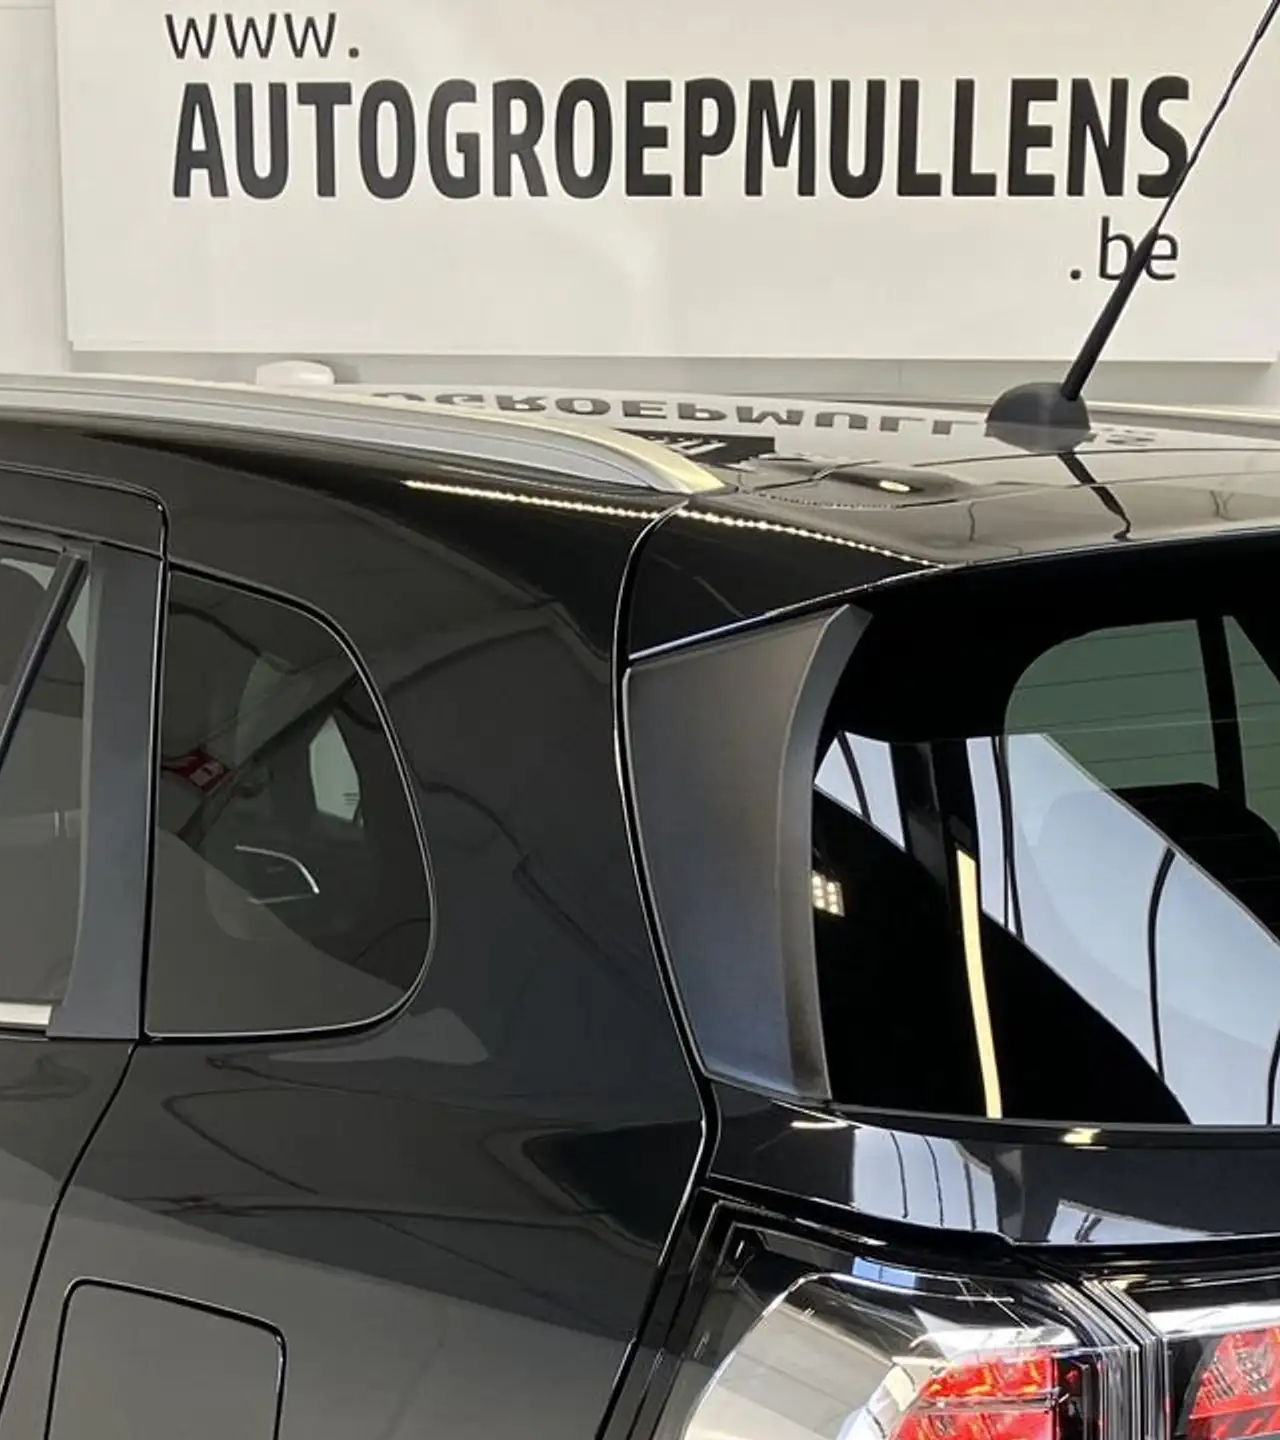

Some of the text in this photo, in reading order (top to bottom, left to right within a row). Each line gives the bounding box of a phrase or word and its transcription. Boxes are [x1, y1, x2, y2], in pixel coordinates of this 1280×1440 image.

[165, 12, 360, 59] www.
[173, 75, 1190, 200] AUTOGROEPMULLENS
[1070, 215, 1179, 281] .be
